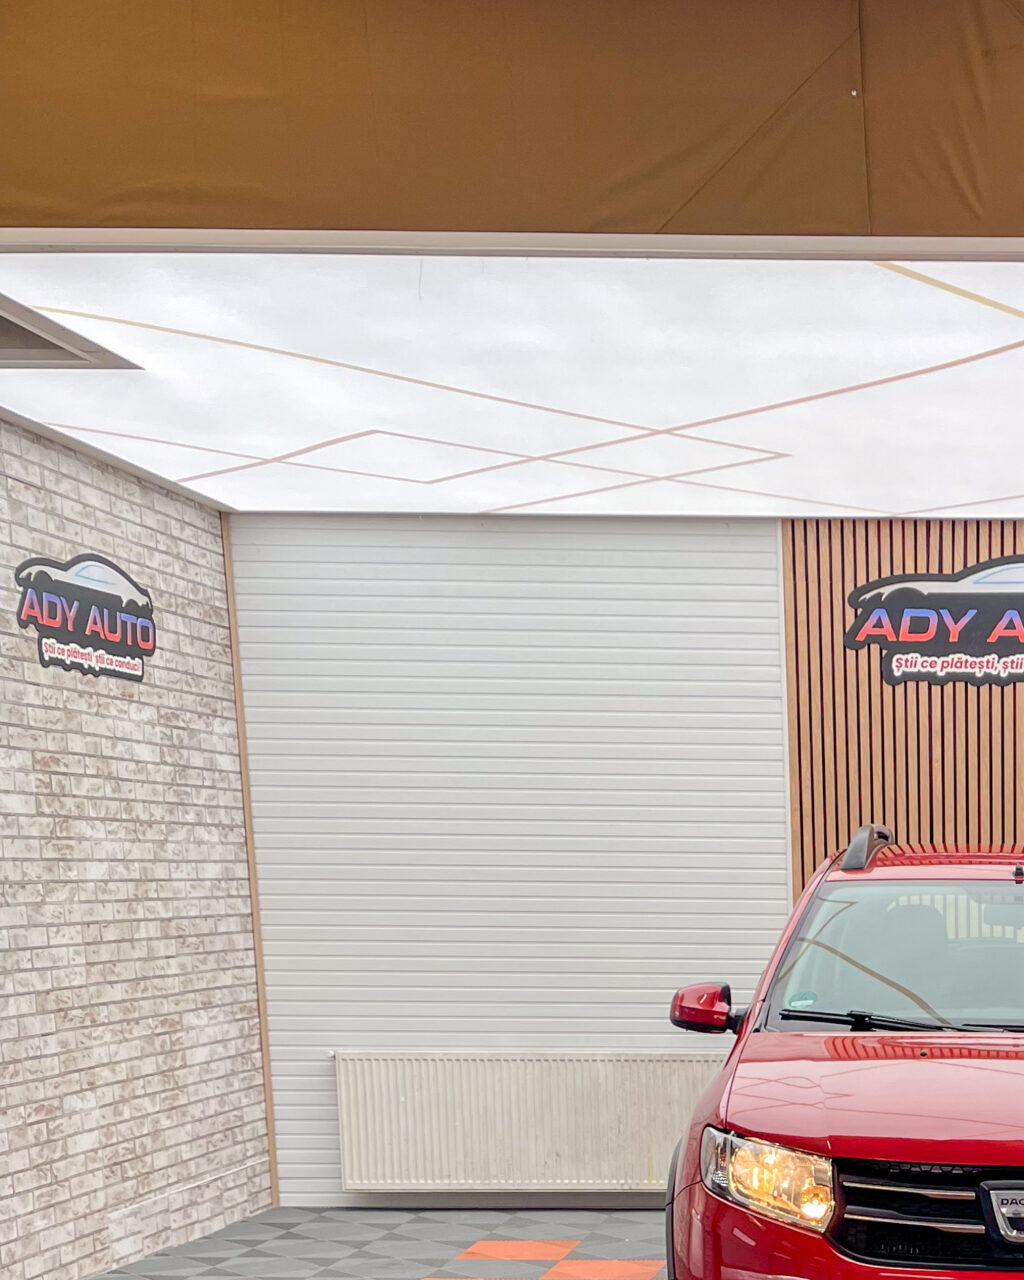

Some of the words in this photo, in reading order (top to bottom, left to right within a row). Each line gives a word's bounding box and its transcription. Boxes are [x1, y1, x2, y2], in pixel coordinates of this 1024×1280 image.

[20, 588, 80, 632] ADY
[85, 605, 154, 650] AUTO
[855, 608, 978, 642] ADY
[57, 646, 65, 656] ce
[106, 657, 114, 667] ce
[920, 659, 938, 669] ce
